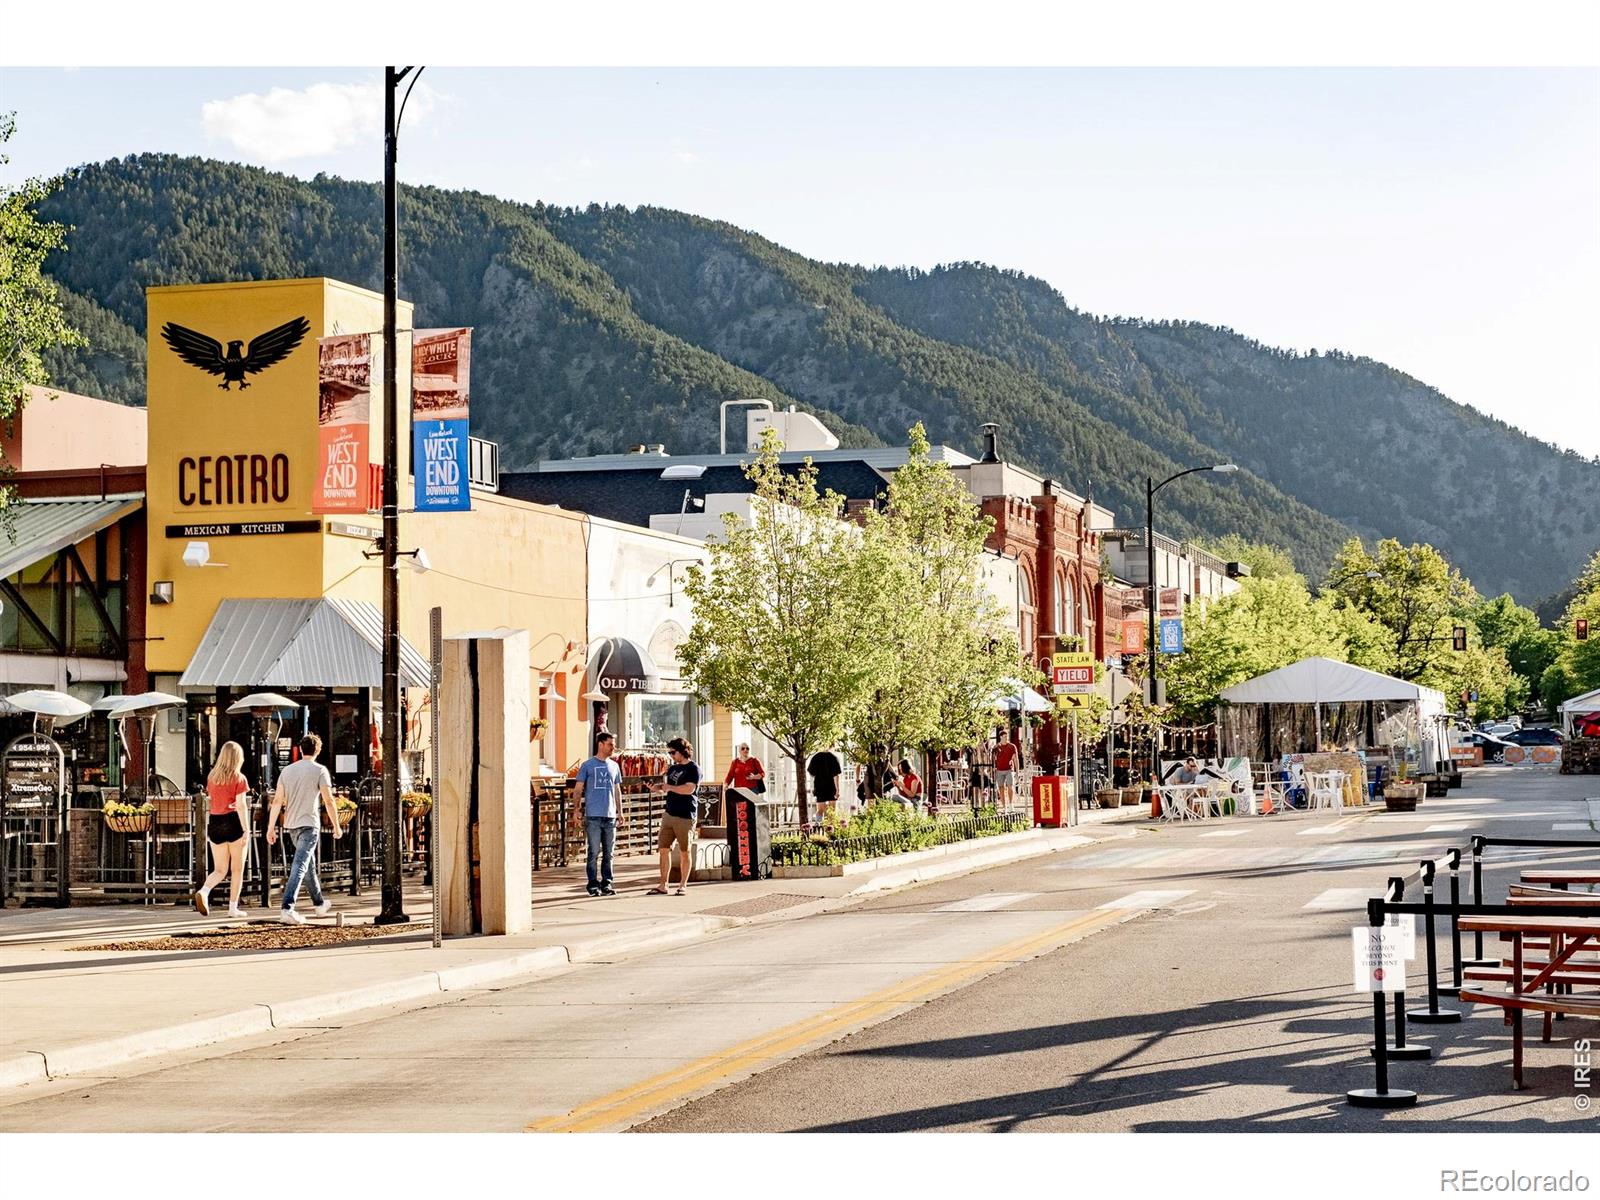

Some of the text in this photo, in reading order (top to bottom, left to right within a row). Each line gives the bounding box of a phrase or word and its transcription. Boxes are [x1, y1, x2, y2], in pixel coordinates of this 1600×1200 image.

[429, 340, 457, 355] WHITE
[327, 442, 359, 464] WEST
[424, 438, 458, 460] WEST
[323, 464, 357, 488] END
[425, 461, 459, 485] END
[179, 453, 289, 506] CENTRO
[323, 489, 357, 498] DOWNTOWN
[425, 486, 459, 496] DOWNTOWN
[184, 524, 285, 535] MEXICAN KITCHEN
[1059, 670, 1088, 681] YIELD
[601, 677, 627, 688] OLD
[11, 783, 53, 791] XtremeGeo
[1371, 934, 1386, 943] NO
